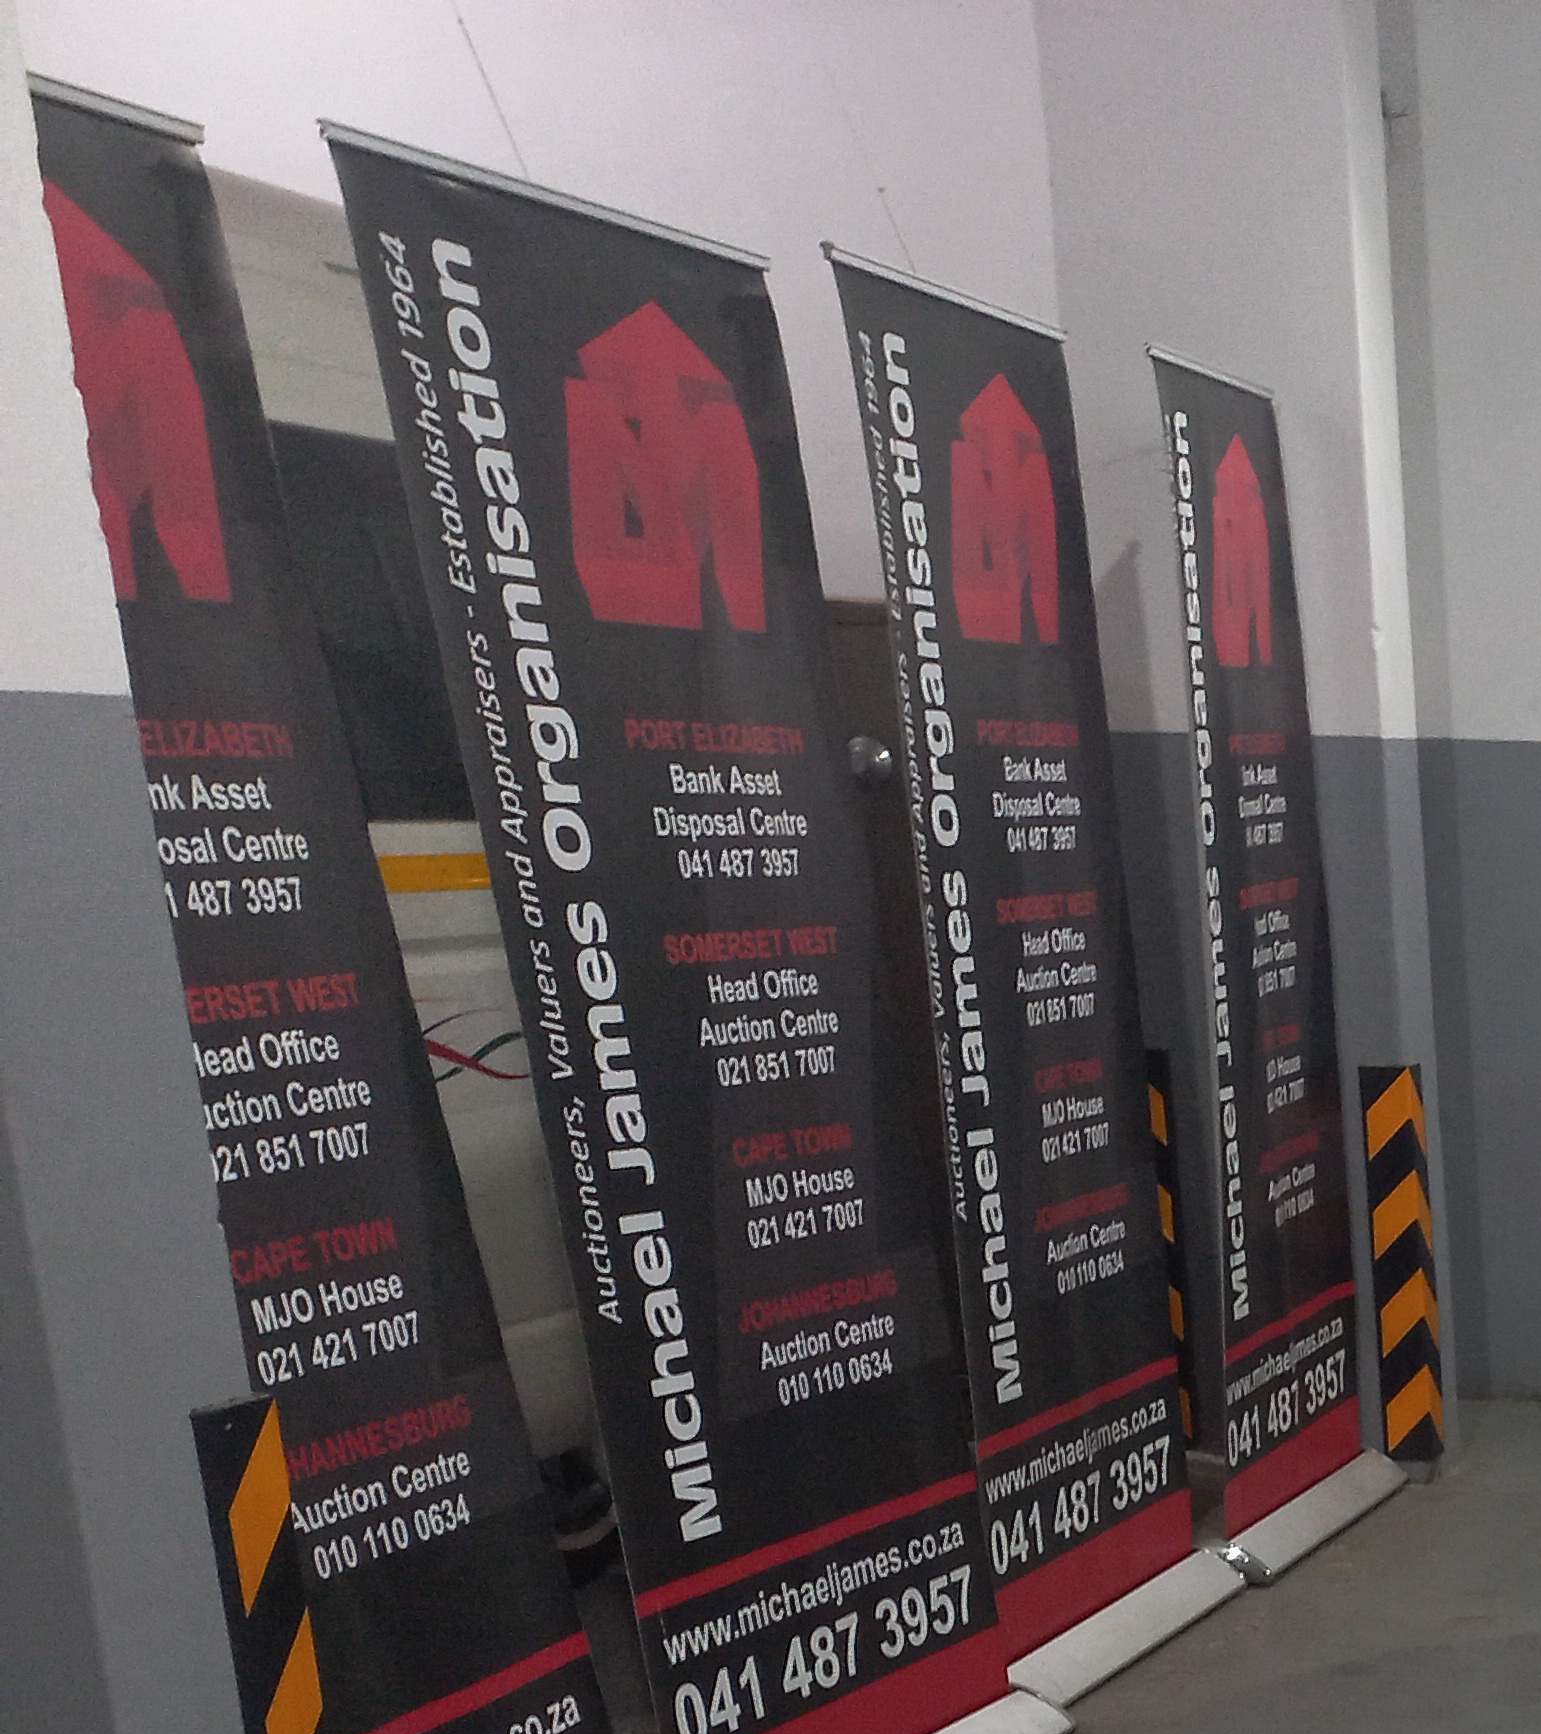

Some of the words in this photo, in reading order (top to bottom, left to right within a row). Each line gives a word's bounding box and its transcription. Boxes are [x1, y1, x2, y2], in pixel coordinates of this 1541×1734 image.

[378, 230, 424, 340] 1964
[401, 348, 477, 595] Established
[431, 238, 592, 871] Organisation
[882, 331, 960, 848] Organisation
[466, 629, 528, 844] Appraisers
[148, 774, 186, 811] nk
[191, 774, 272, 810] Asset
[669, 763, 725, 795] Bank
[730, 766, 782, 796] Asset
[157, 827, 218, 865] osal
[222, 826, 309, 862] Centre
[652, 807, 746, 842] Disposal
[750, 807, 808, 837] Centre
[187, 880, 231, 916] 487
[242, 877, 302, 914] 3957
[505, 850, 543, 928] and
[677, 850, 714, 879] 041
[719, 849, 753, 878] 487
[760, 848, 799, 877] 3957
[1051, 927, 1086, 953] Office
[1206, 866, 1233, 1068] James
[185, 979, 281, 1025] ERSET
[287, 973, 360, 1013] WEST
[529, 938, 574, 1080] Valuers
[707, 972, 759, 1003] Head
[763, 969, 818, 999] Office
[943, 869, 990, 1107] James
[259, 1030, 341, 1069] Office
[566, 901, 655, 1186] James
[700, 1015, 776, 1048] Auction
[780, 1009, 839, 1038] Centre
[717, 1056, 751, 1087] 021
[756, 1050, 790, 1081] 851
[795, 1045, 835, 1076] 7007
[287, 1078, 371, 1117] Centre
[257, 1133, 305, 1174] 851
[309, 1122, 369, 1164] 7007
[563, 1096, 623, 1325] Auctioneers,
[745, 1174, 788, 1208] MJO
[792, 1167, 855, 1198] House
[747, 1215, 780, 1249] 021
[785, 1208, 817, 1240] 421
[822, 1199, 863, 1232] 7007
[1218, 1085, 1250, 1321] Michael
[230, 1235, 312, 1286] CAPE
[320, 1217, 399, 1266] TOWN
[966, 1127, 1023, 1404] Michael
[251, 1288, 313, 1335] MJO
[319, 1273, 404, 1317] House
[761, 1330, 831, 1370] Auction
[835, 1314, 895, 1348] Centre
[257, 1343, 304, 1387] 021
[312, 1328, 358, 1370] 421
[362, 1310, 420, 1356] 7007
[618, 1210, 722, 1542] Michael
[778, 1372, 810, 1406] 010
[814, 1362, 845, 1394] 110
[849, 1348, 893, 1385] 0634
[1228, 1404, 1261, 1468] 041
[1305, 1348, 1346, 1416] 3957
[986, 1397, 1167, 1505] www.michaeljames.co.za
[289, 1481, 388, 1535] Auction
[392, 1451, 471, 1499] Centre
[991, 1500, 1044, 1575] 041
[1054, 1471, 1101, 1539] 487
[1110, 1435, 1170, 1511] 3957
[313, 1535, 358, 1581] 010
[363, 1516, 409, 1559] 110
[415, 1493, 471, 1542] 0634
[663, 1521, 965, 1666] www.michaeljames.co.za
[782, 1612, 859, 1699] 487
[875, 1565, 972, 1658] 3957
